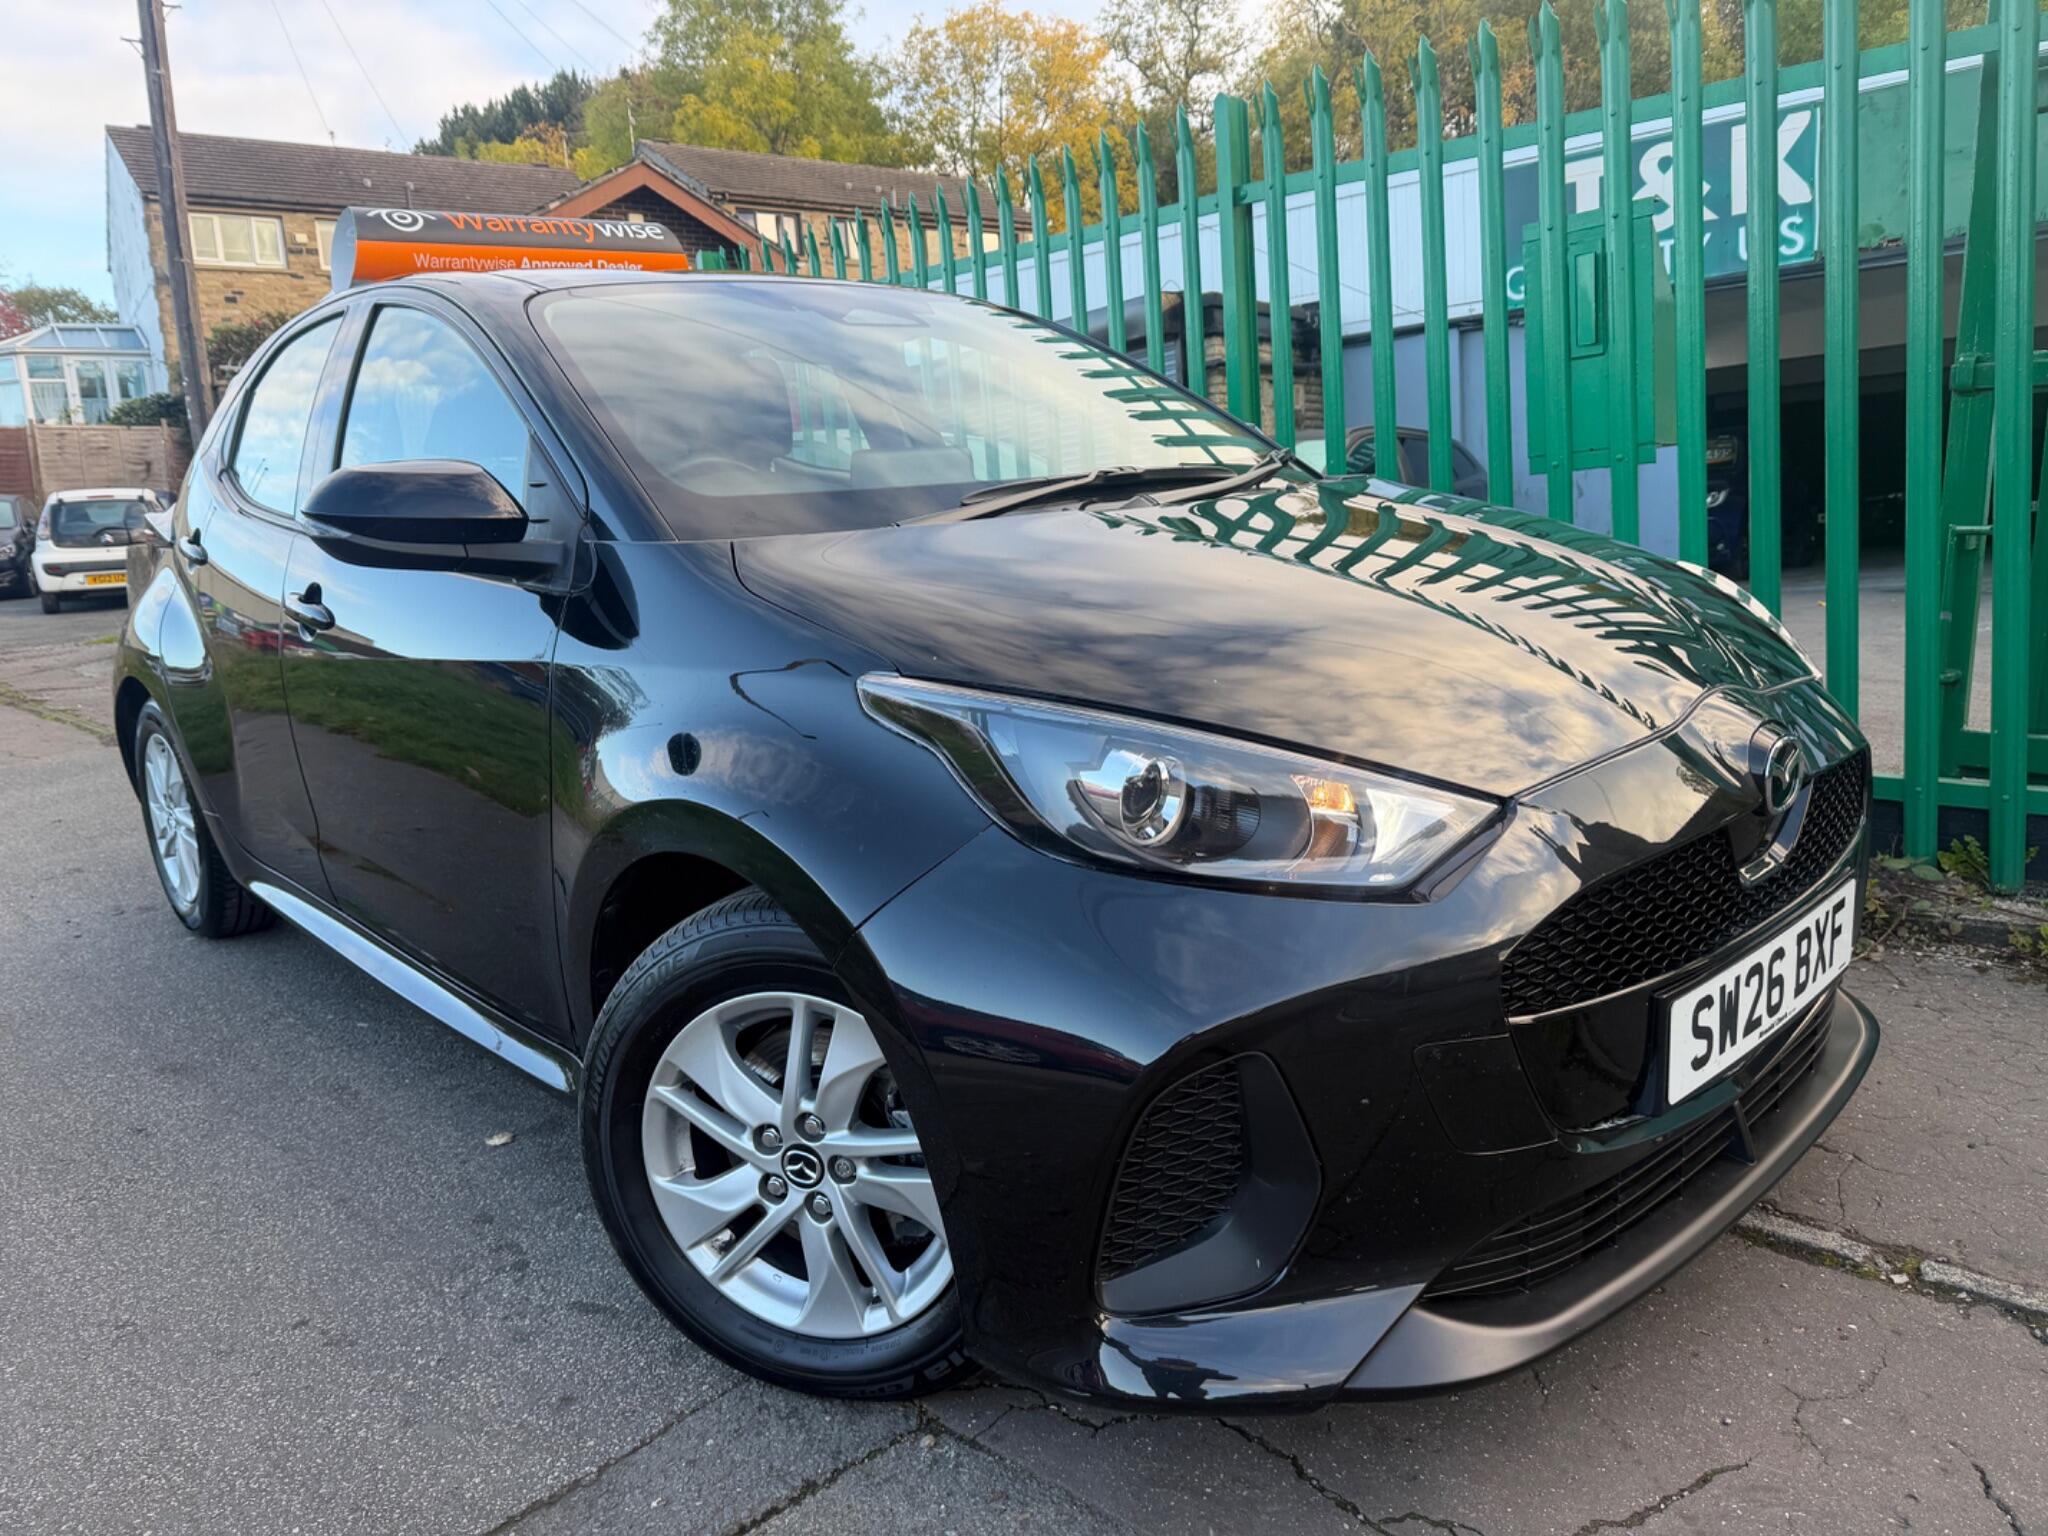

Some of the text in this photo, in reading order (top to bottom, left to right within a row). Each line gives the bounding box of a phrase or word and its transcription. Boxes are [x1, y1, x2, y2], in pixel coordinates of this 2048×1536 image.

[443, 211, 665, 243] Warrantywise
[413, 253, 516, 272] Warrantywise
[1691, 897, 1846, 1071] SW26 BXF
